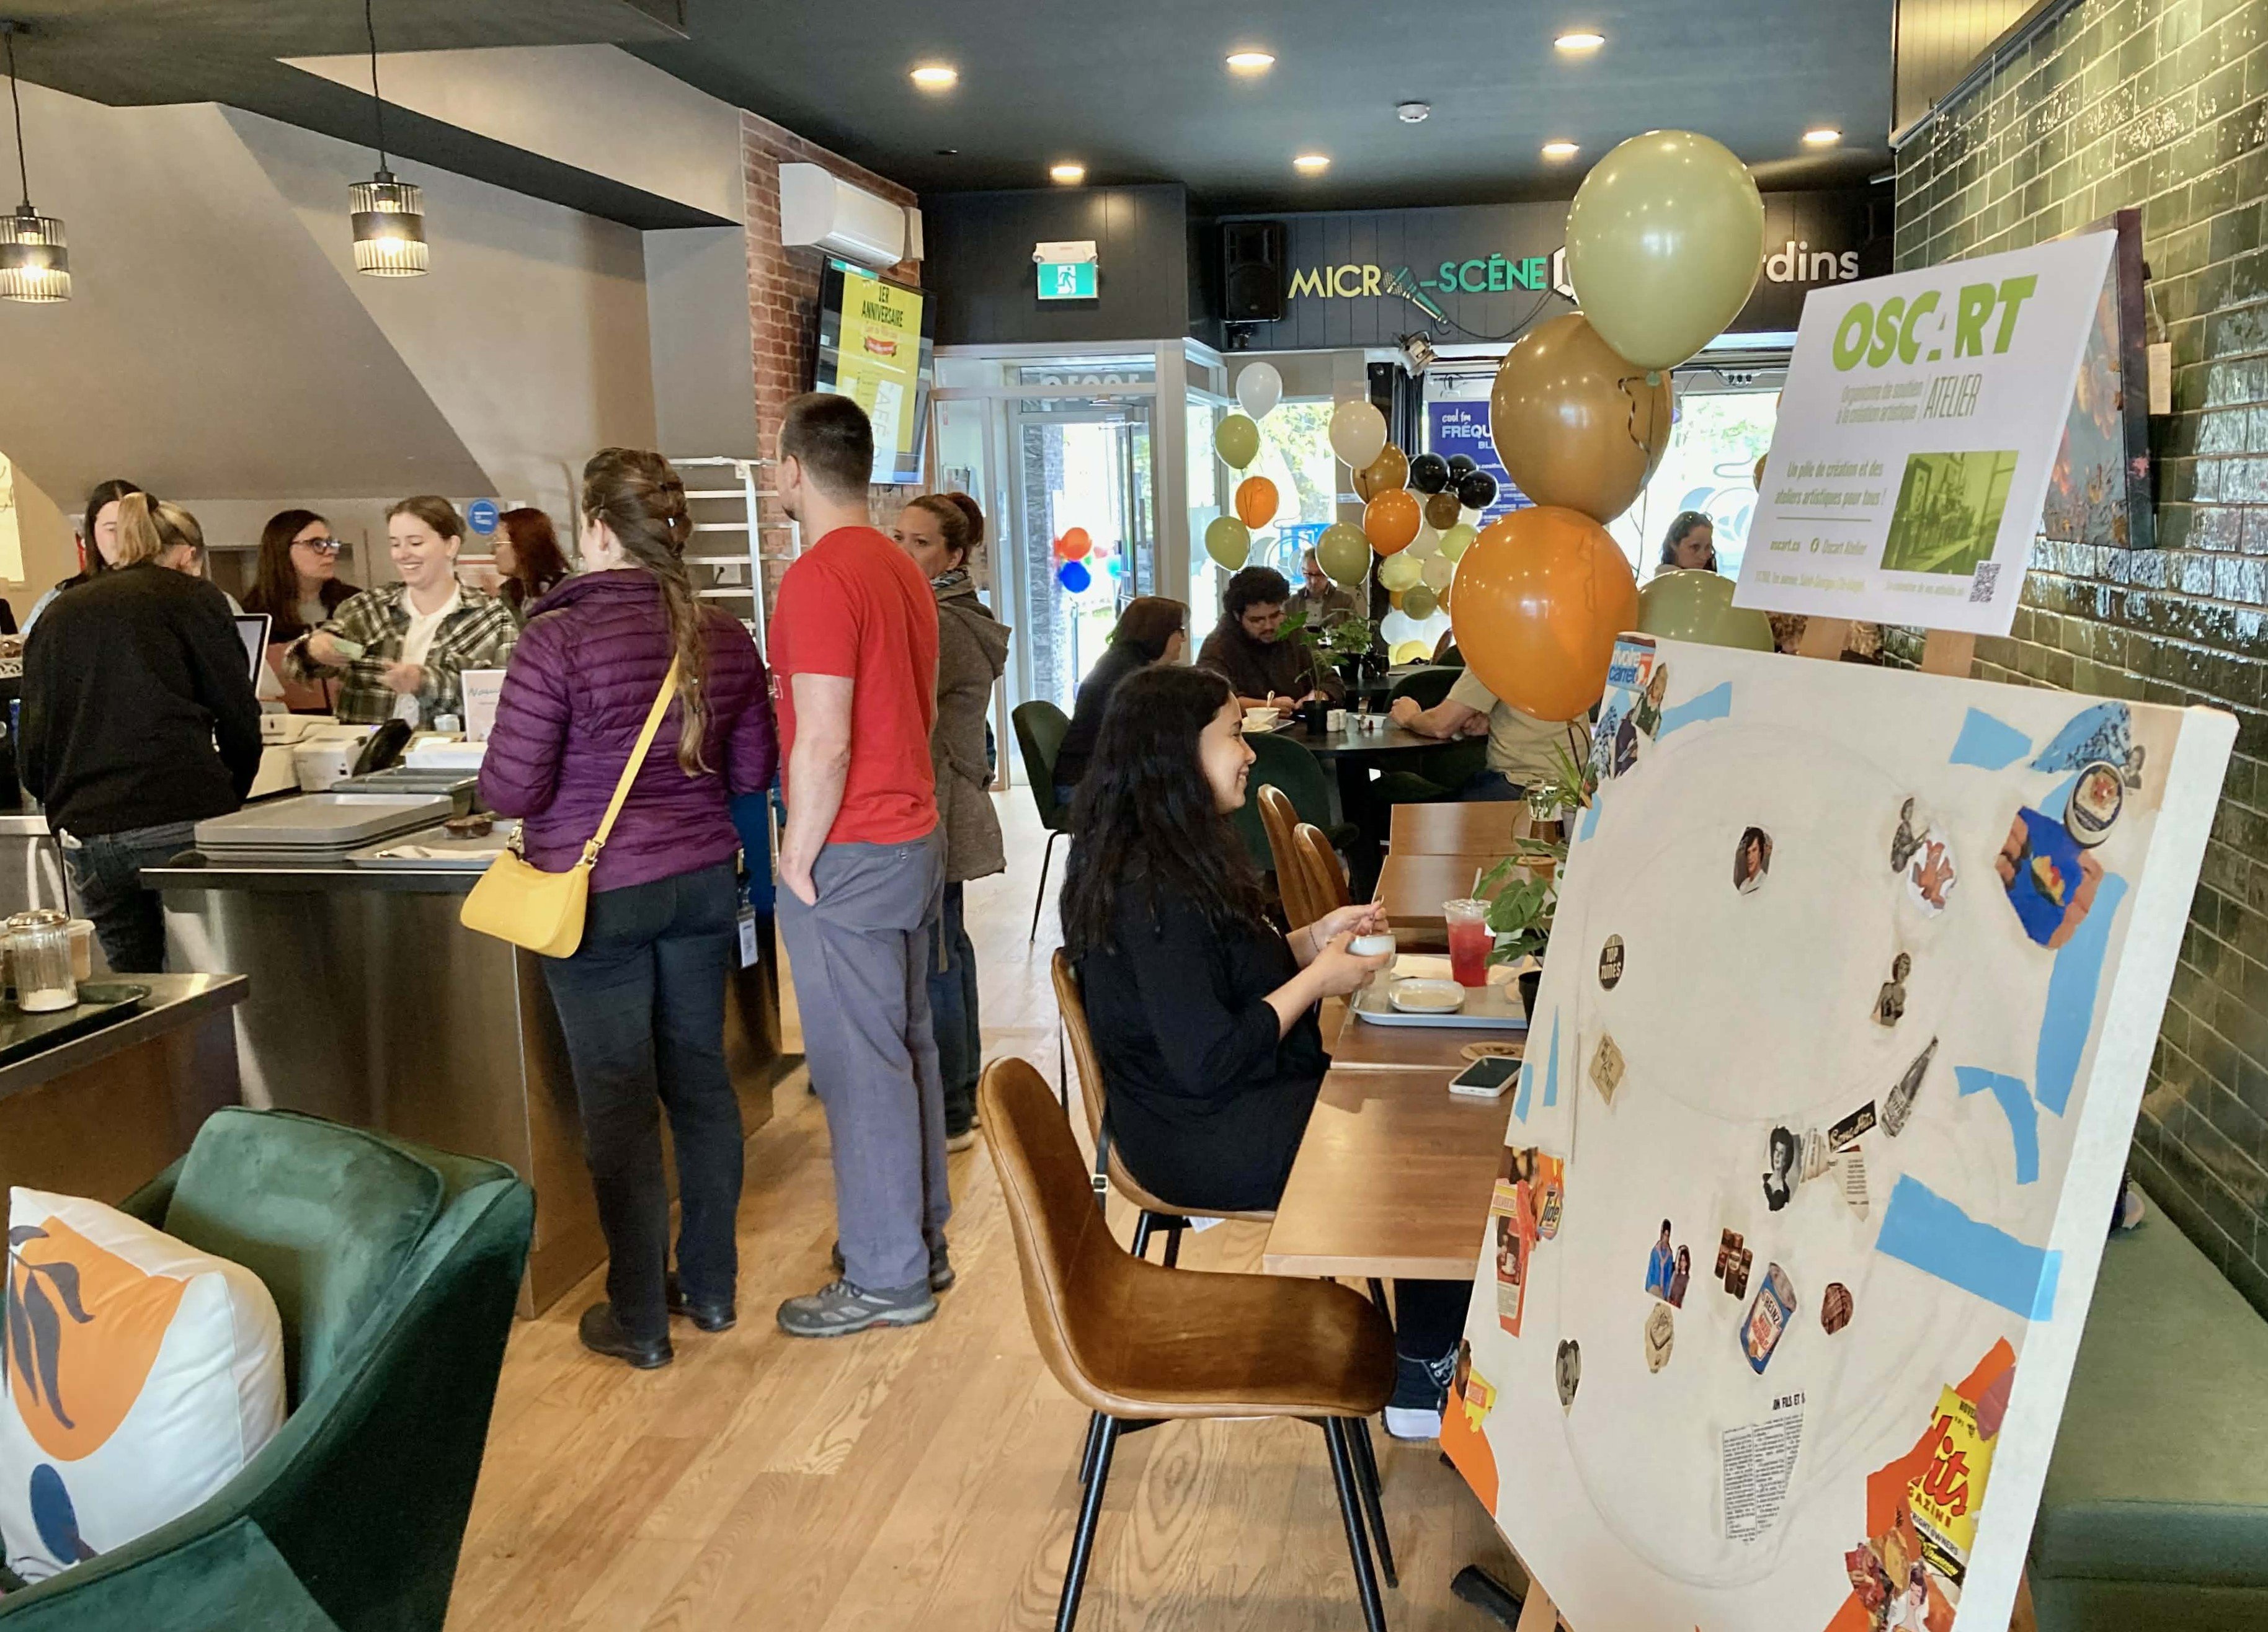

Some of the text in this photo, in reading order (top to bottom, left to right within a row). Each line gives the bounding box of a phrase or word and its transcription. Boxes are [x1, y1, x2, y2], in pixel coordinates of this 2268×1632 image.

[1763, 241, 1859, 282] dins
[879, 285, 889, 303] 1ER
[861, 300, 904, 327] ANNIVERSAIRE
[1923, 373, 1983, 419] ATELIER
[1442, 408, 1471, 423] cool fm
[1815, 460, 1825, 477] de
[1859, 460, 1869, 476] et
[1867, 459, 1883, 477] des
[1606, 946, 1619, 962] TOP
[1601, 961, 1622, 979] TUNES
[1539, 1191, 1560, 1227] Tide
[1764, 1296, 1780, 1324] HEINZ
